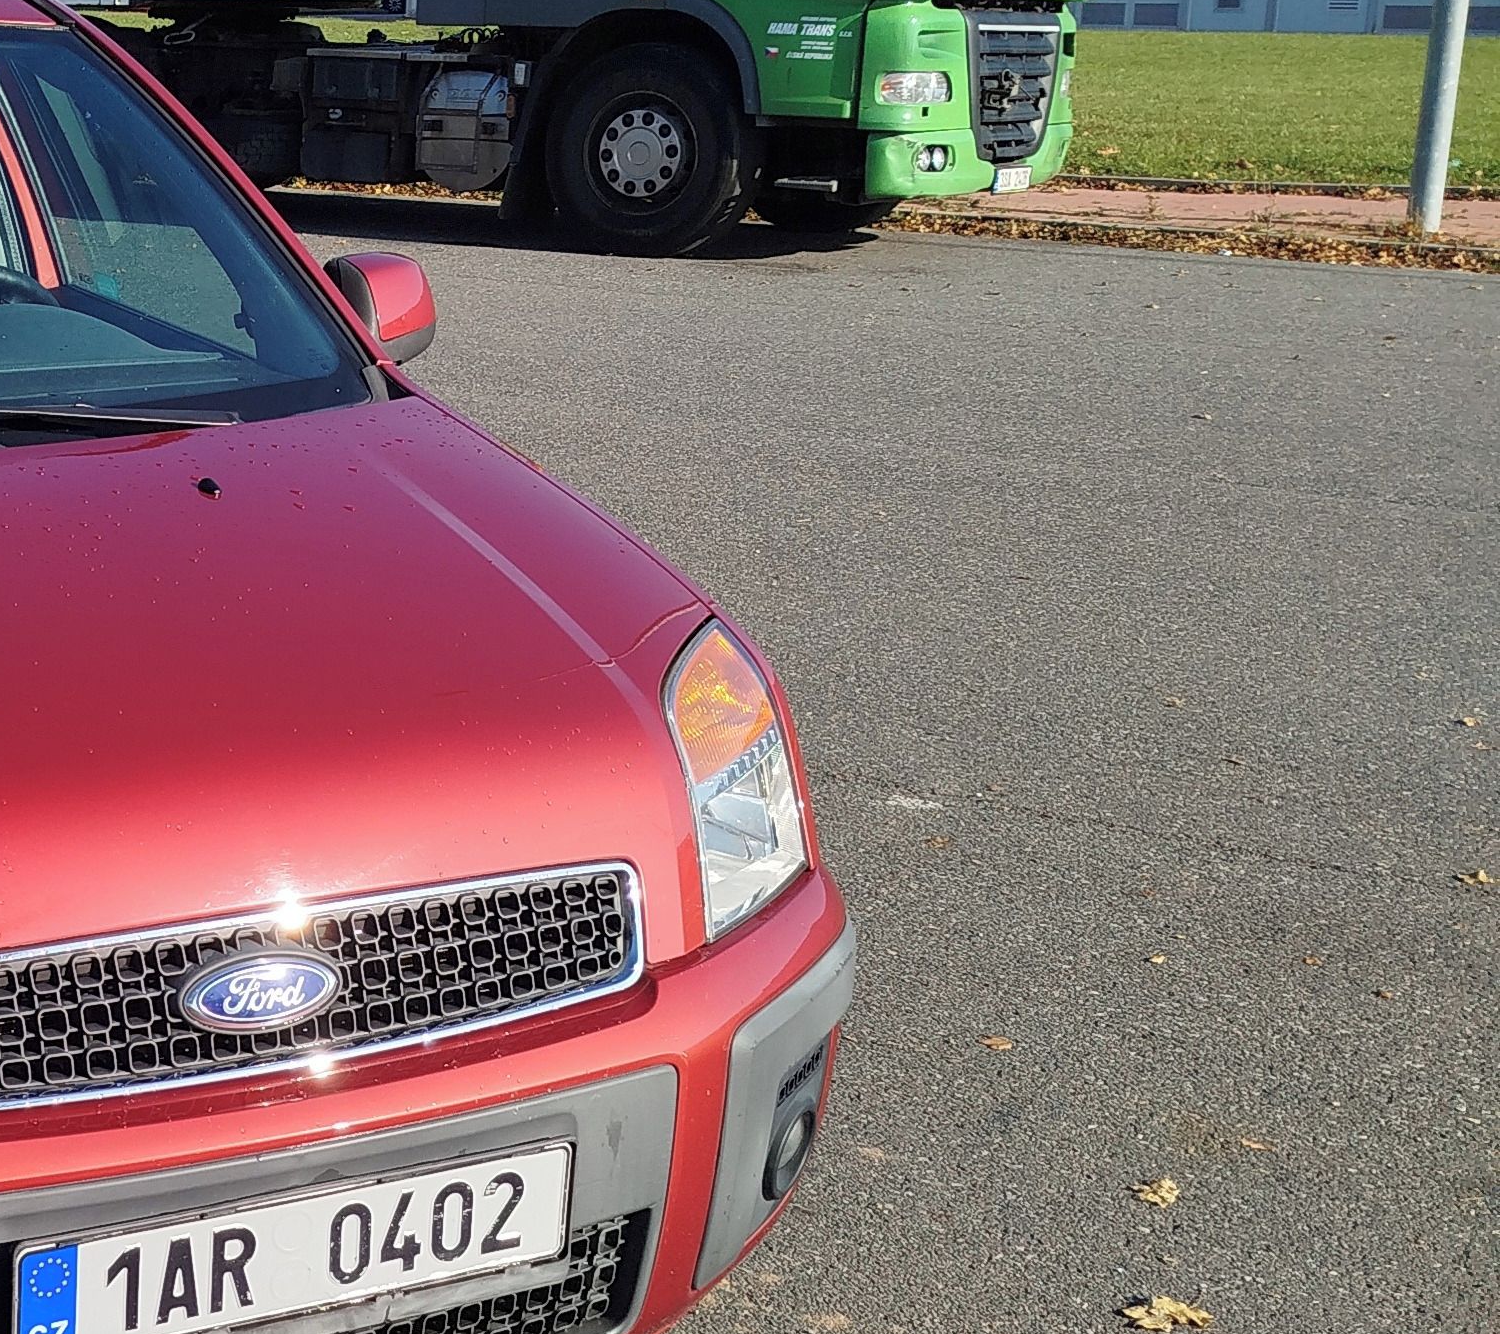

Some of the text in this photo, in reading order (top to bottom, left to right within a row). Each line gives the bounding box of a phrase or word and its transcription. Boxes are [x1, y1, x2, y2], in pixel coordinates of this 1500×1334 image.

[766, 22, 799, 35] HAMA
[800, 23, 837, 37] TRANS
[222, 975, 306, 1015] Ford
[104, 1225, 258, 1332] 1AR
[327, 1170, 525, 1287] 0402
